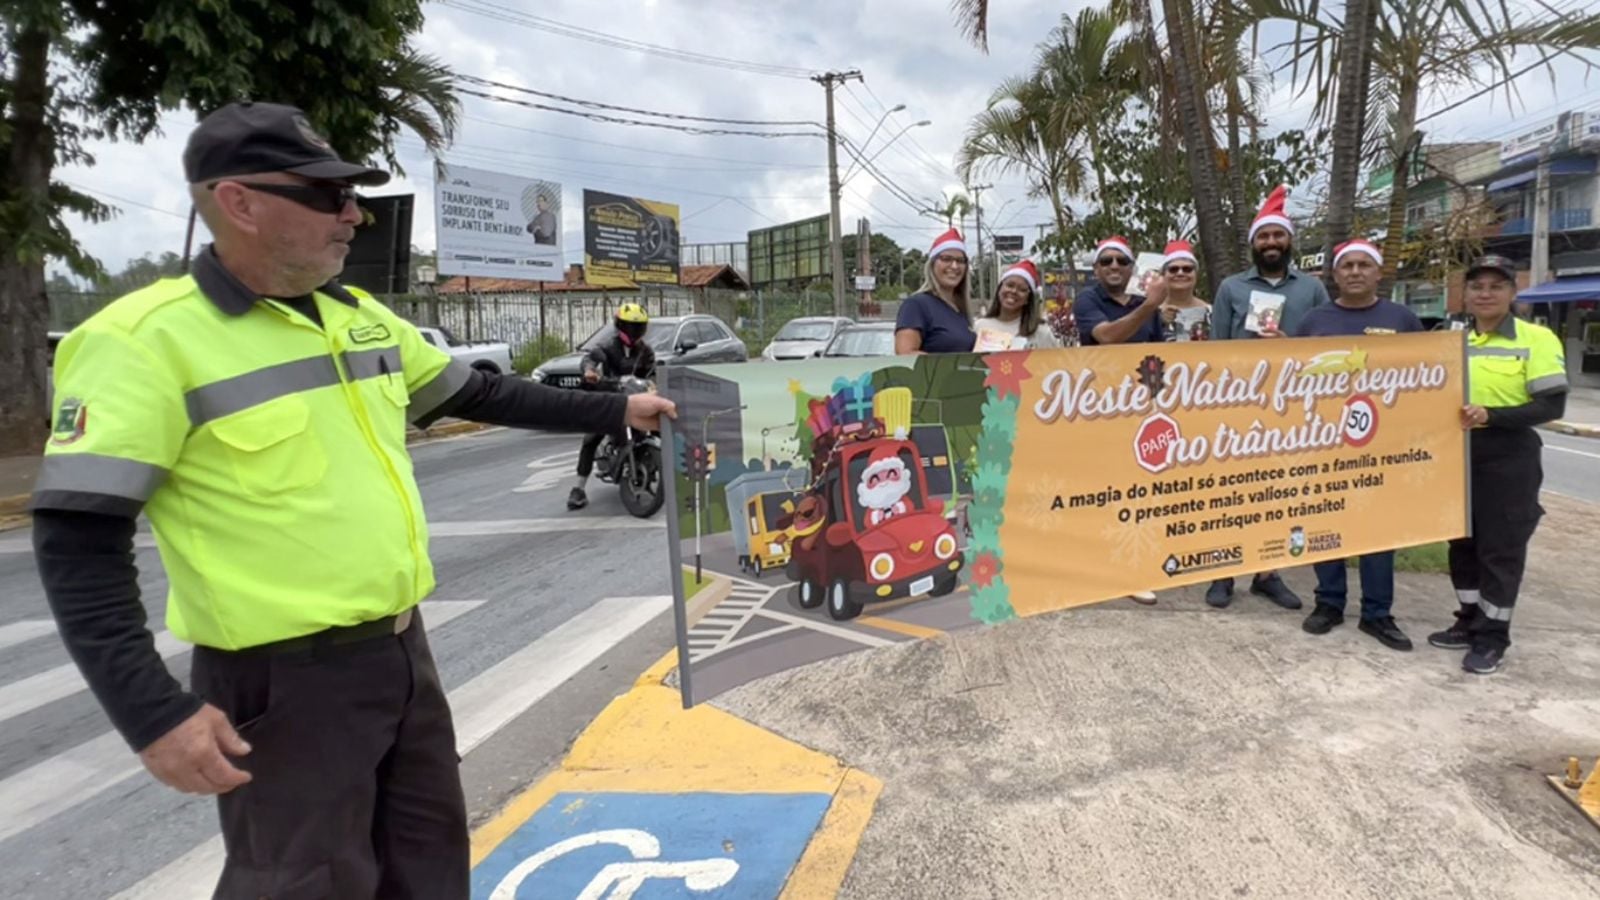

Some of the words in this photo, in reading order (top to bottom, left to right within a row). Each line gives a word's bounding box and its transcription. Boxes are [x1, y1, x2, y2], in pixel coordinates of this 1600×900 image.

[441, 191, 494, 209] TRANSFORME
[496, 199, 509, 210] SEU
[441, 204, 476, 218] SORRISO
[478, 209, 494, 220] COM
[441, 217, 482, 232] IMPLANTE
[1034, 368, 1151, 421] Neste
[1156, 359, 1268, 409] Natal,
[1273, 357, 1350, 412] fique
[1354, 361, 1446, 405] seguro
[1165, 434, 1208, 463] no
[1213, 404, 1350, 458] trânsito!
[1347, 409, 1370, 432] 50
[1140, 428, 1174, 458] PARE
[1051, 495, 1065, 511] A
[1069, 486, 1122, 508] magia
[1127, 484, 1147, 499] do
[1152, 477, 1193, 496] Natal
[1197, 474, 1215, 490] só
[1219, 466, 1285, 486] acontece
[1289, 463, 1318, 477] com
[1321, 463, 1330, 473] a
[1333, 454, 1377, 471] família
[1381, 449, 1432, 466] reunida.
[1118, 508, 1131, 523] O
[1135, 500, 1205, 524] presente
[1209, 491, 1244, 510] mais
[1248, 485, 1298, 503] valioso
[1302, 482, 1310, 496] é
[1314, 484, 1322, 494] a
[1325, 480, 1348, 493] sua
[1352, 472, 1383, 489] vida!
[1166, 521, 1196, 537] Não
[1200, 511, 1262, 533] arrisque
[1265, 508, 1284, 522] no
[1287, 497, 1345, 518] trânsito!
